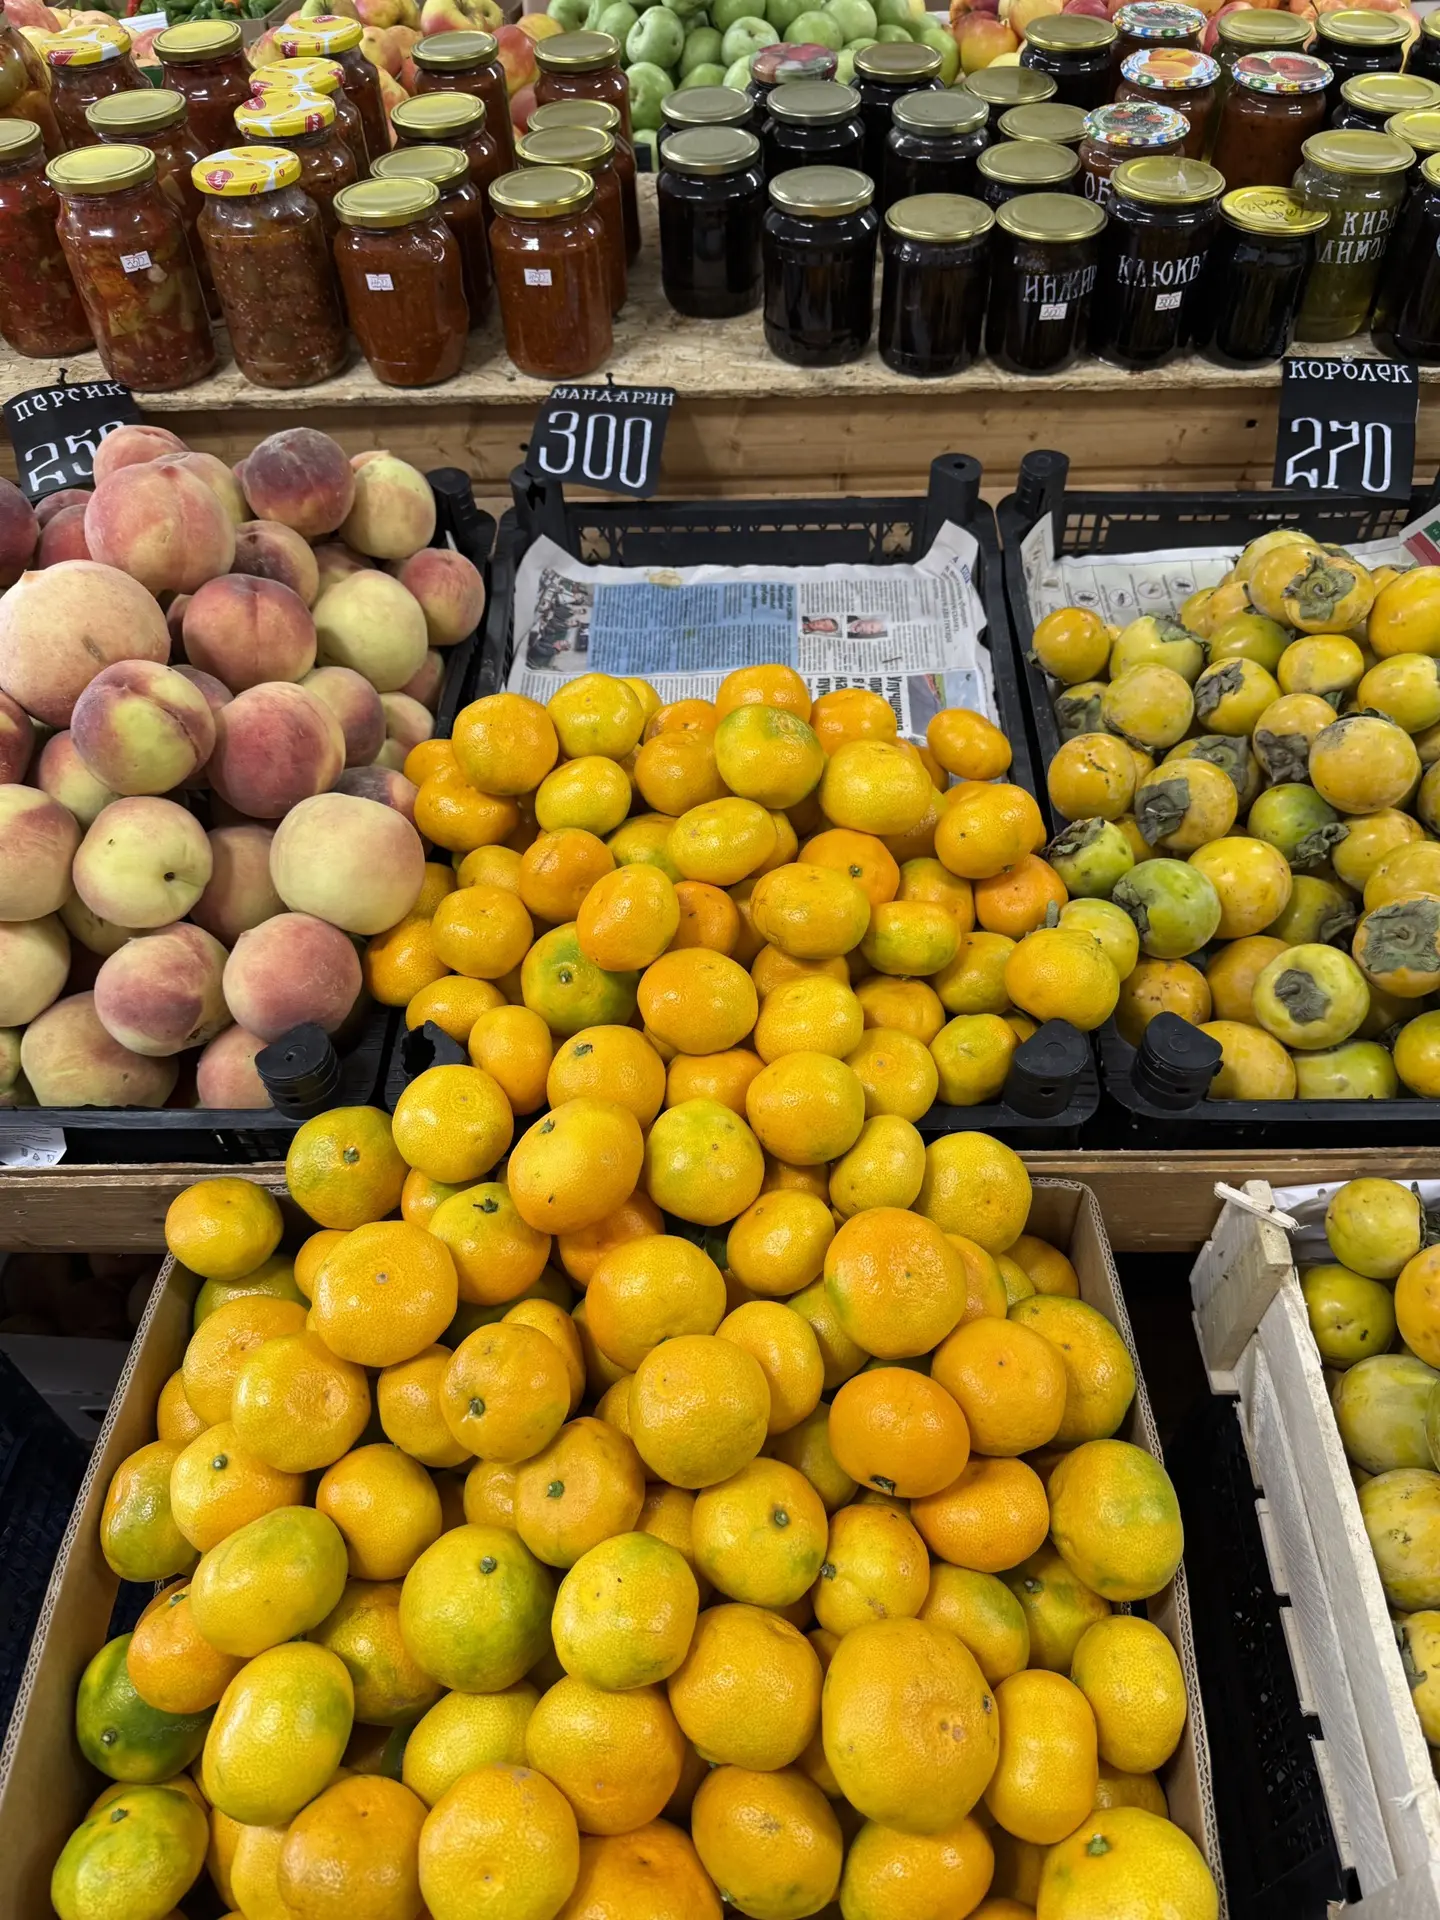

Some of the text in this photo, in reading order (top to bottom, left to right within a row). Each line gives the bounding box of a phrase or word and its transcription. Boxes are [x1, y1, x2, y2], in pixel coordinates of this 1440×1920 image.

[1117, 250, 1208, 287] КЛЮКВ
[1289, 361, 1412, 383] КОРОЛЕК
[12, 383, 127, 422] ПЕРСИК
[551, 388, 675, 406] МАНДАРИН
[539, 410, 652, 488] 300
[1285, 417, 1392, 492] 270
